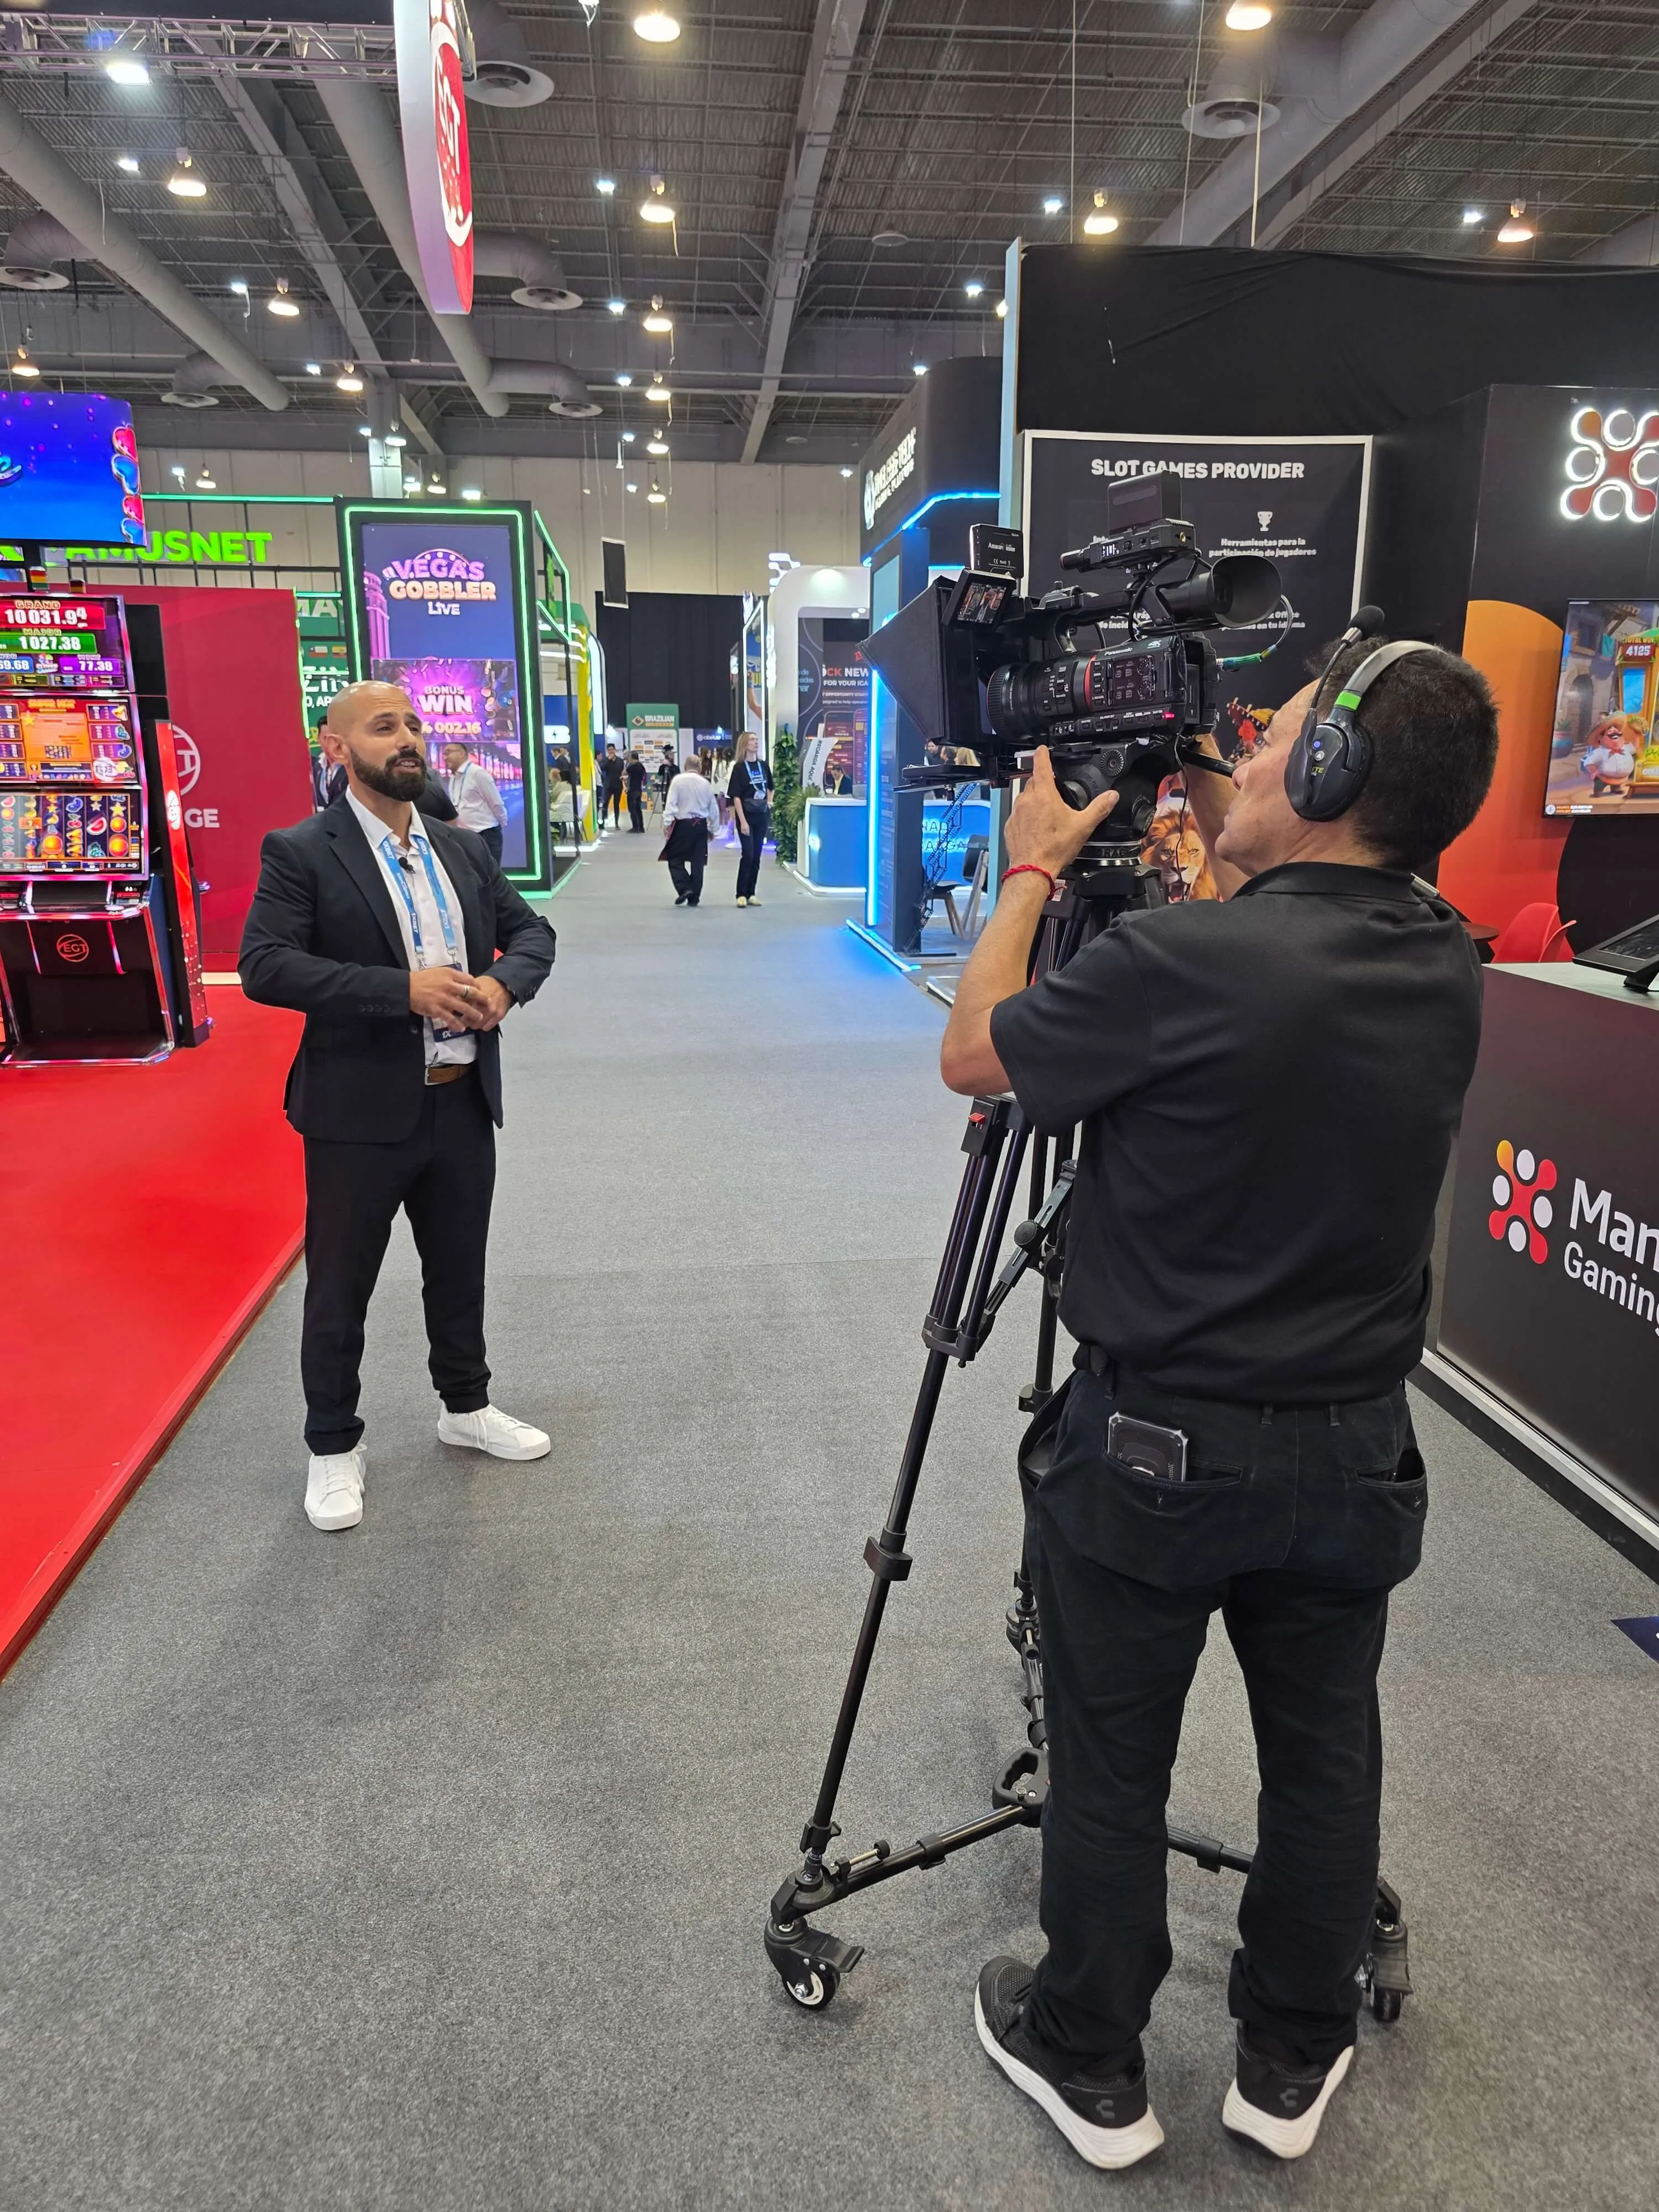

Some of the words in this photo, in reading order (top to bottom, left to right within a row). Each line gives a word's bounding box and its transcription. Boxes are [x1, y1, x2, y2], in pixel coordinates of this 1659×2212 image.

[1091, 459, 1140, 476] SLOT
[1142, 461, 1208, 478] GAMES
[1211, 462, 1305, 479] PROVIDER
[1221, 538, 1277, 546] Herramientas
[1278, 539, 1297, 547] para
[1275, 548, 1317, 557] jugadores
[392, 558, 485, 581] VEGAS
[389, 581, 497, 600] GOBBLER
[14, 600, 60, 609] GRAND
[428, 602, 461, 615] LIVE
[1626, 645, 1651, 656] 4125
[424, 686, 464, 695] BONUS
[418, 695, 474, 714] WIN
[64, 944, 87, 952] EGT
[1569, 1177, 1659, 1273] Man
[1564, 1241, 1659, 1337] Gamin
